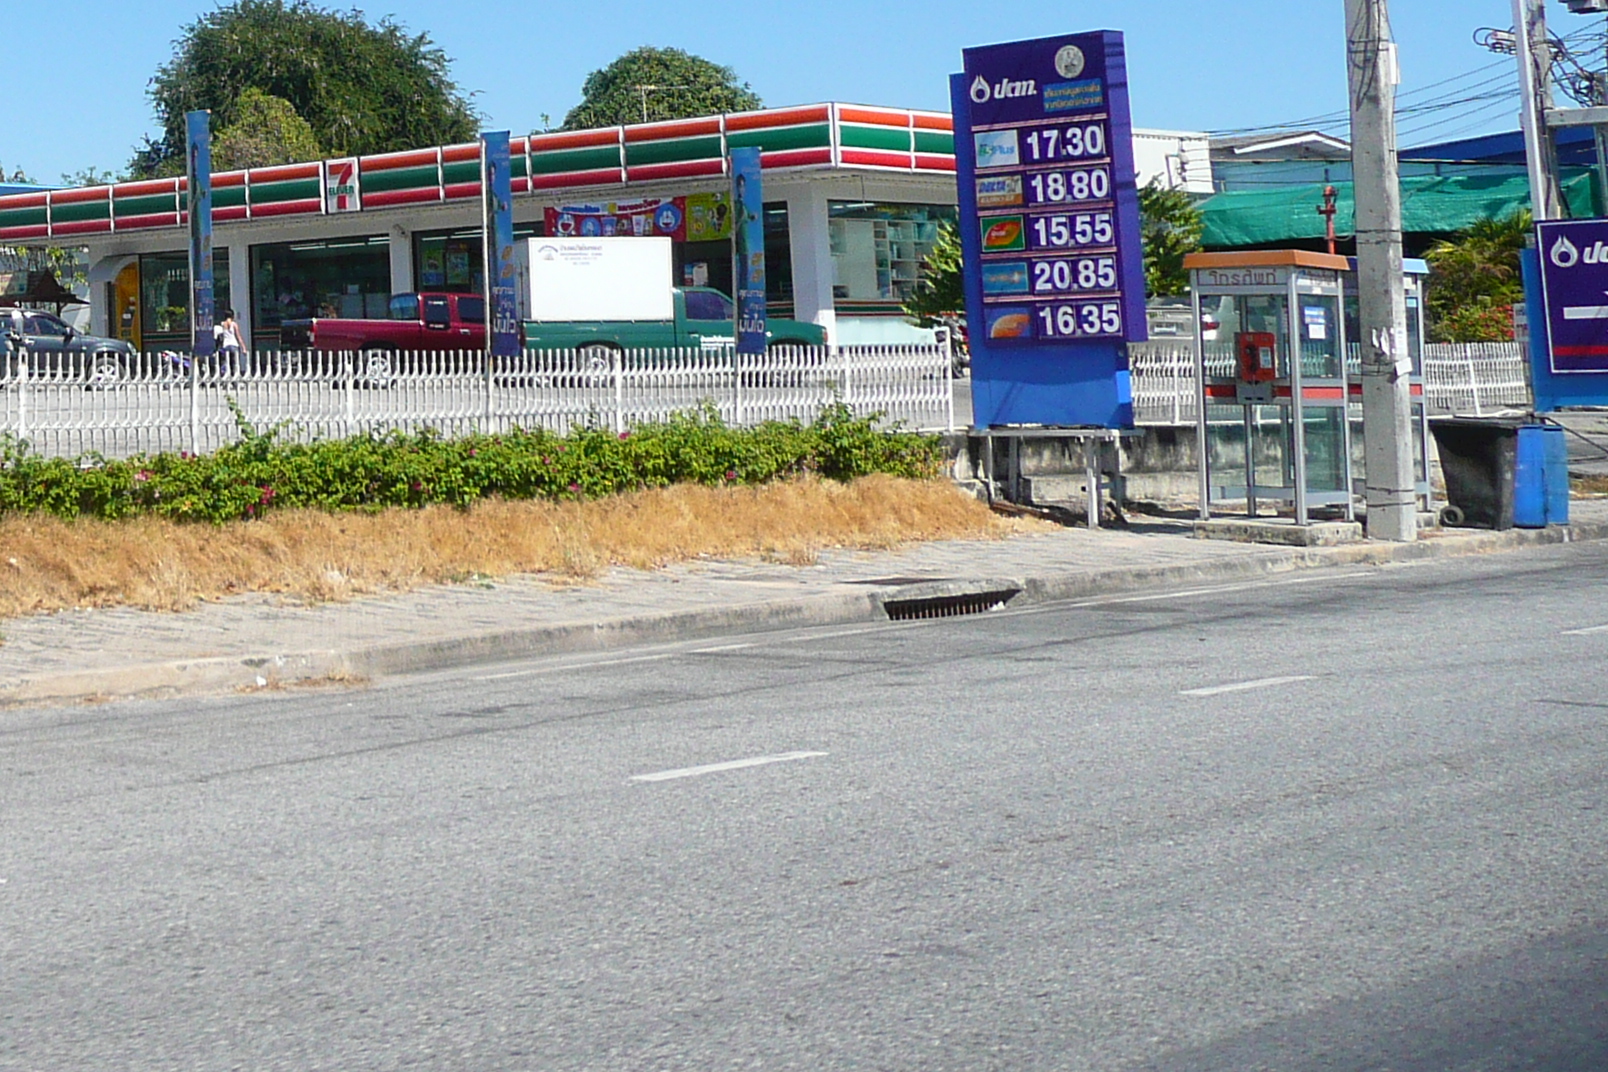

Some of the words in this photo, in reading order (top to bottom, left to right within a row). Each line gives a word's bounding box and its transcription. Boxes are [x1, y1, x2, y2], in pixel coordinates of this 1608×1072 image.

[1026, 125, 1103, 159] 17.30
[1031, 168, 1109, 203] 18.80
[1034, 212, 1112, 247] 15.55
[1034, 258, 1114, 290] 20.85
[1208, 268, 1277, 286] โทรศัพท์
[1039, 303, 1120, 336] 16.35
